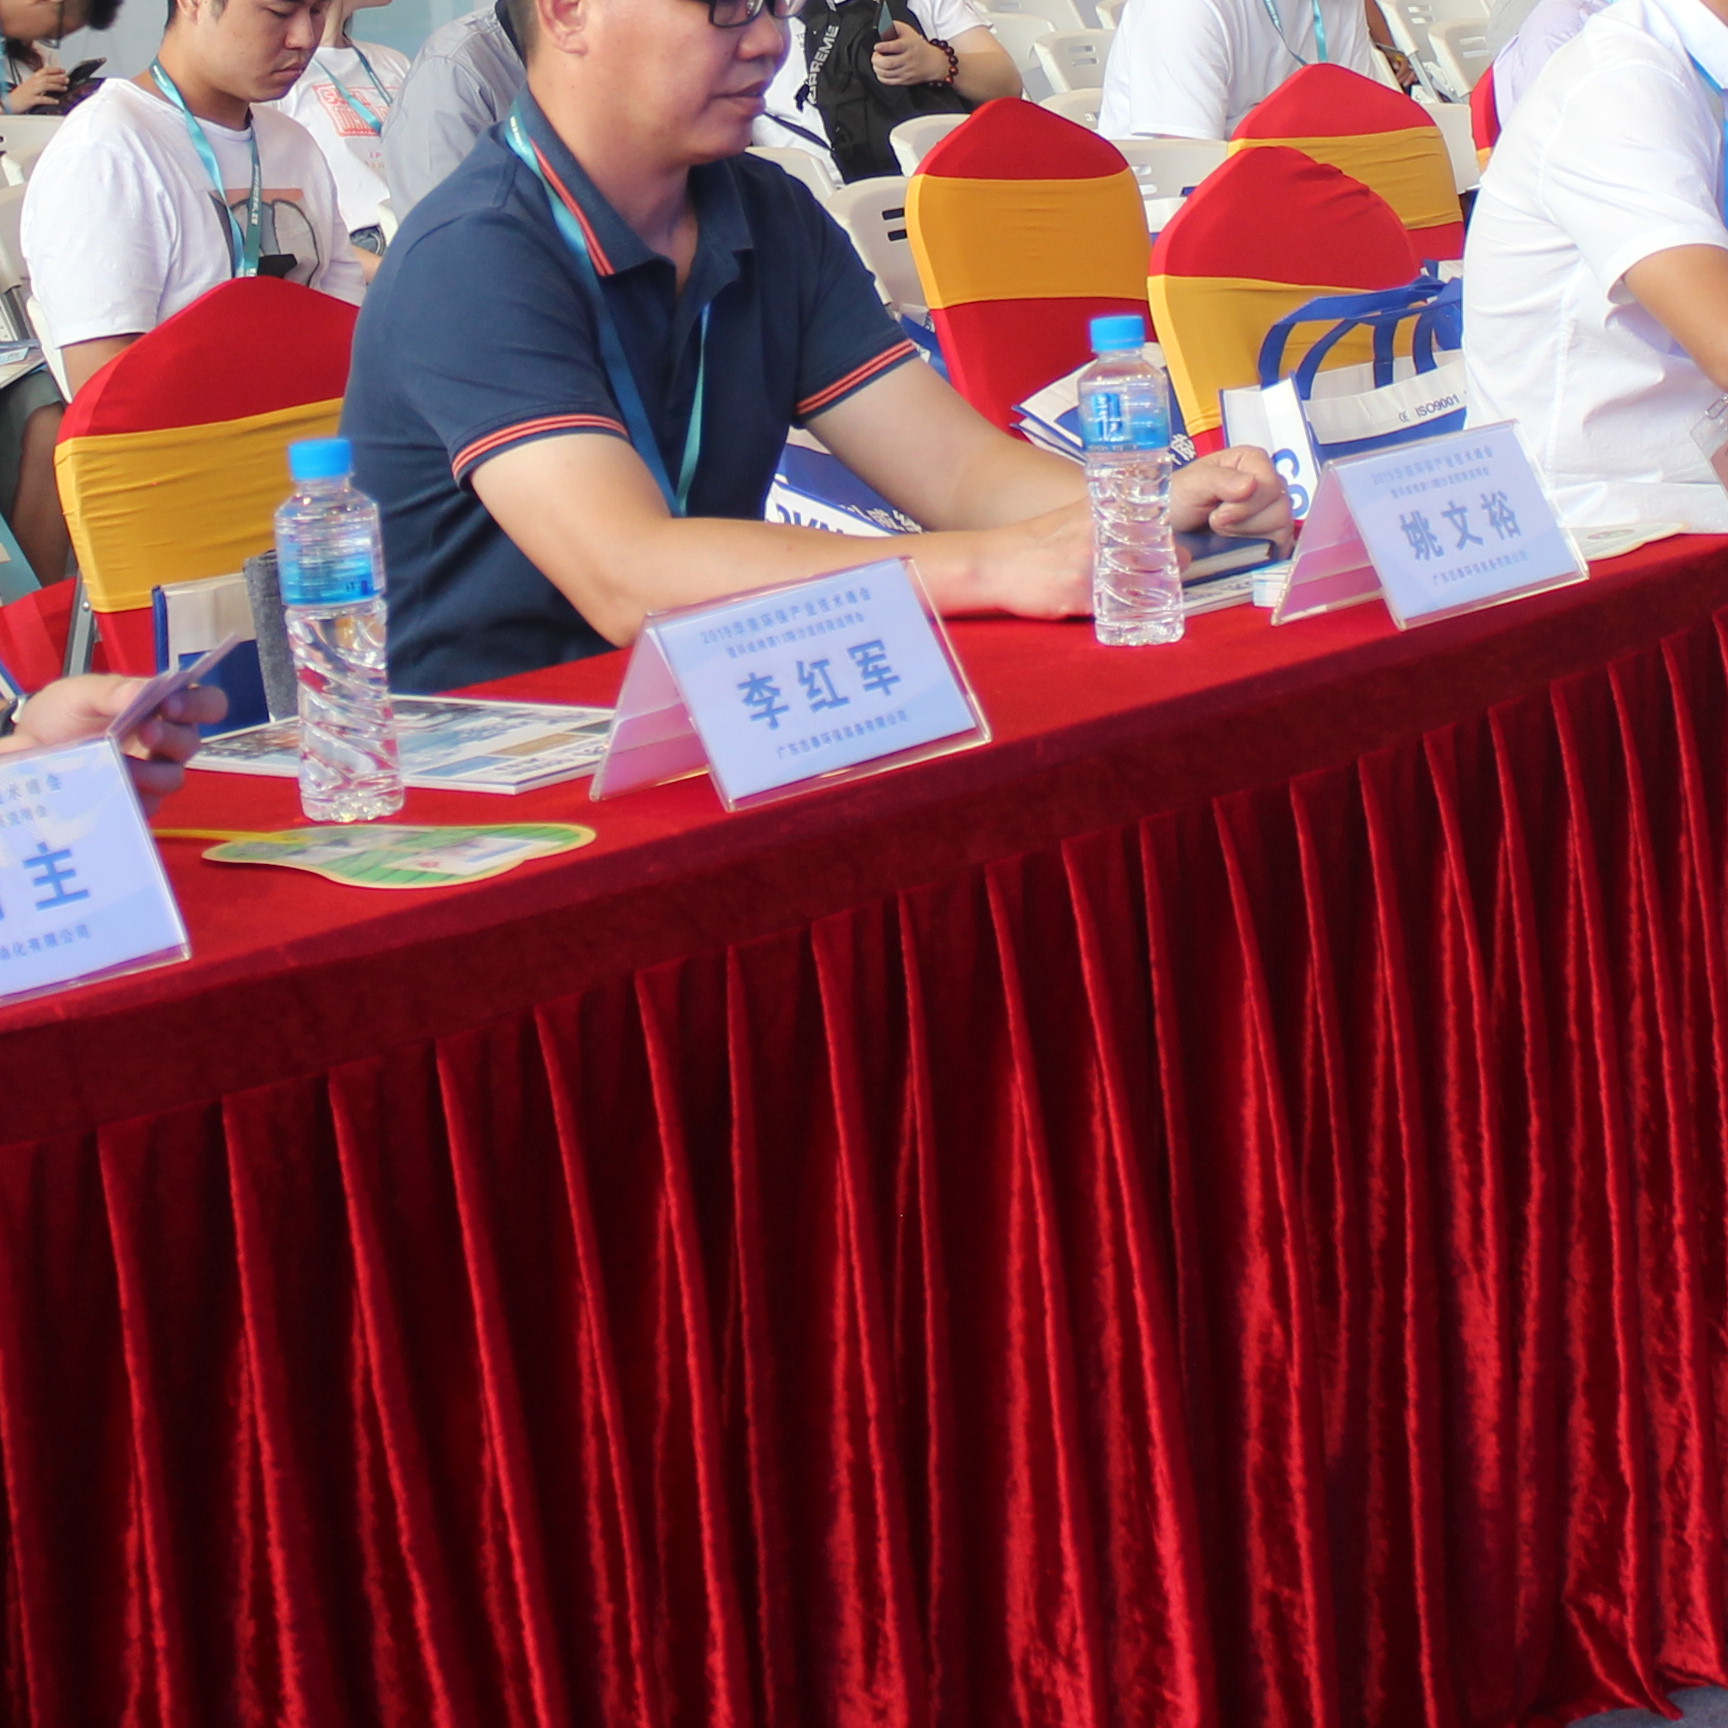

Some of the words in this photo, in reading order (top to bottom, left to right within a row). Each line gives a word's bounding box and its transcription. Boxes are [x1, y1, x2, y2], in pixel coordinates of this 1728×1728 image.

[1415, 393, 1461, 418] ISO9001
[1399, 490, 1522, 562] 姚文裕
[736, 639, 902, 730] 李红军
